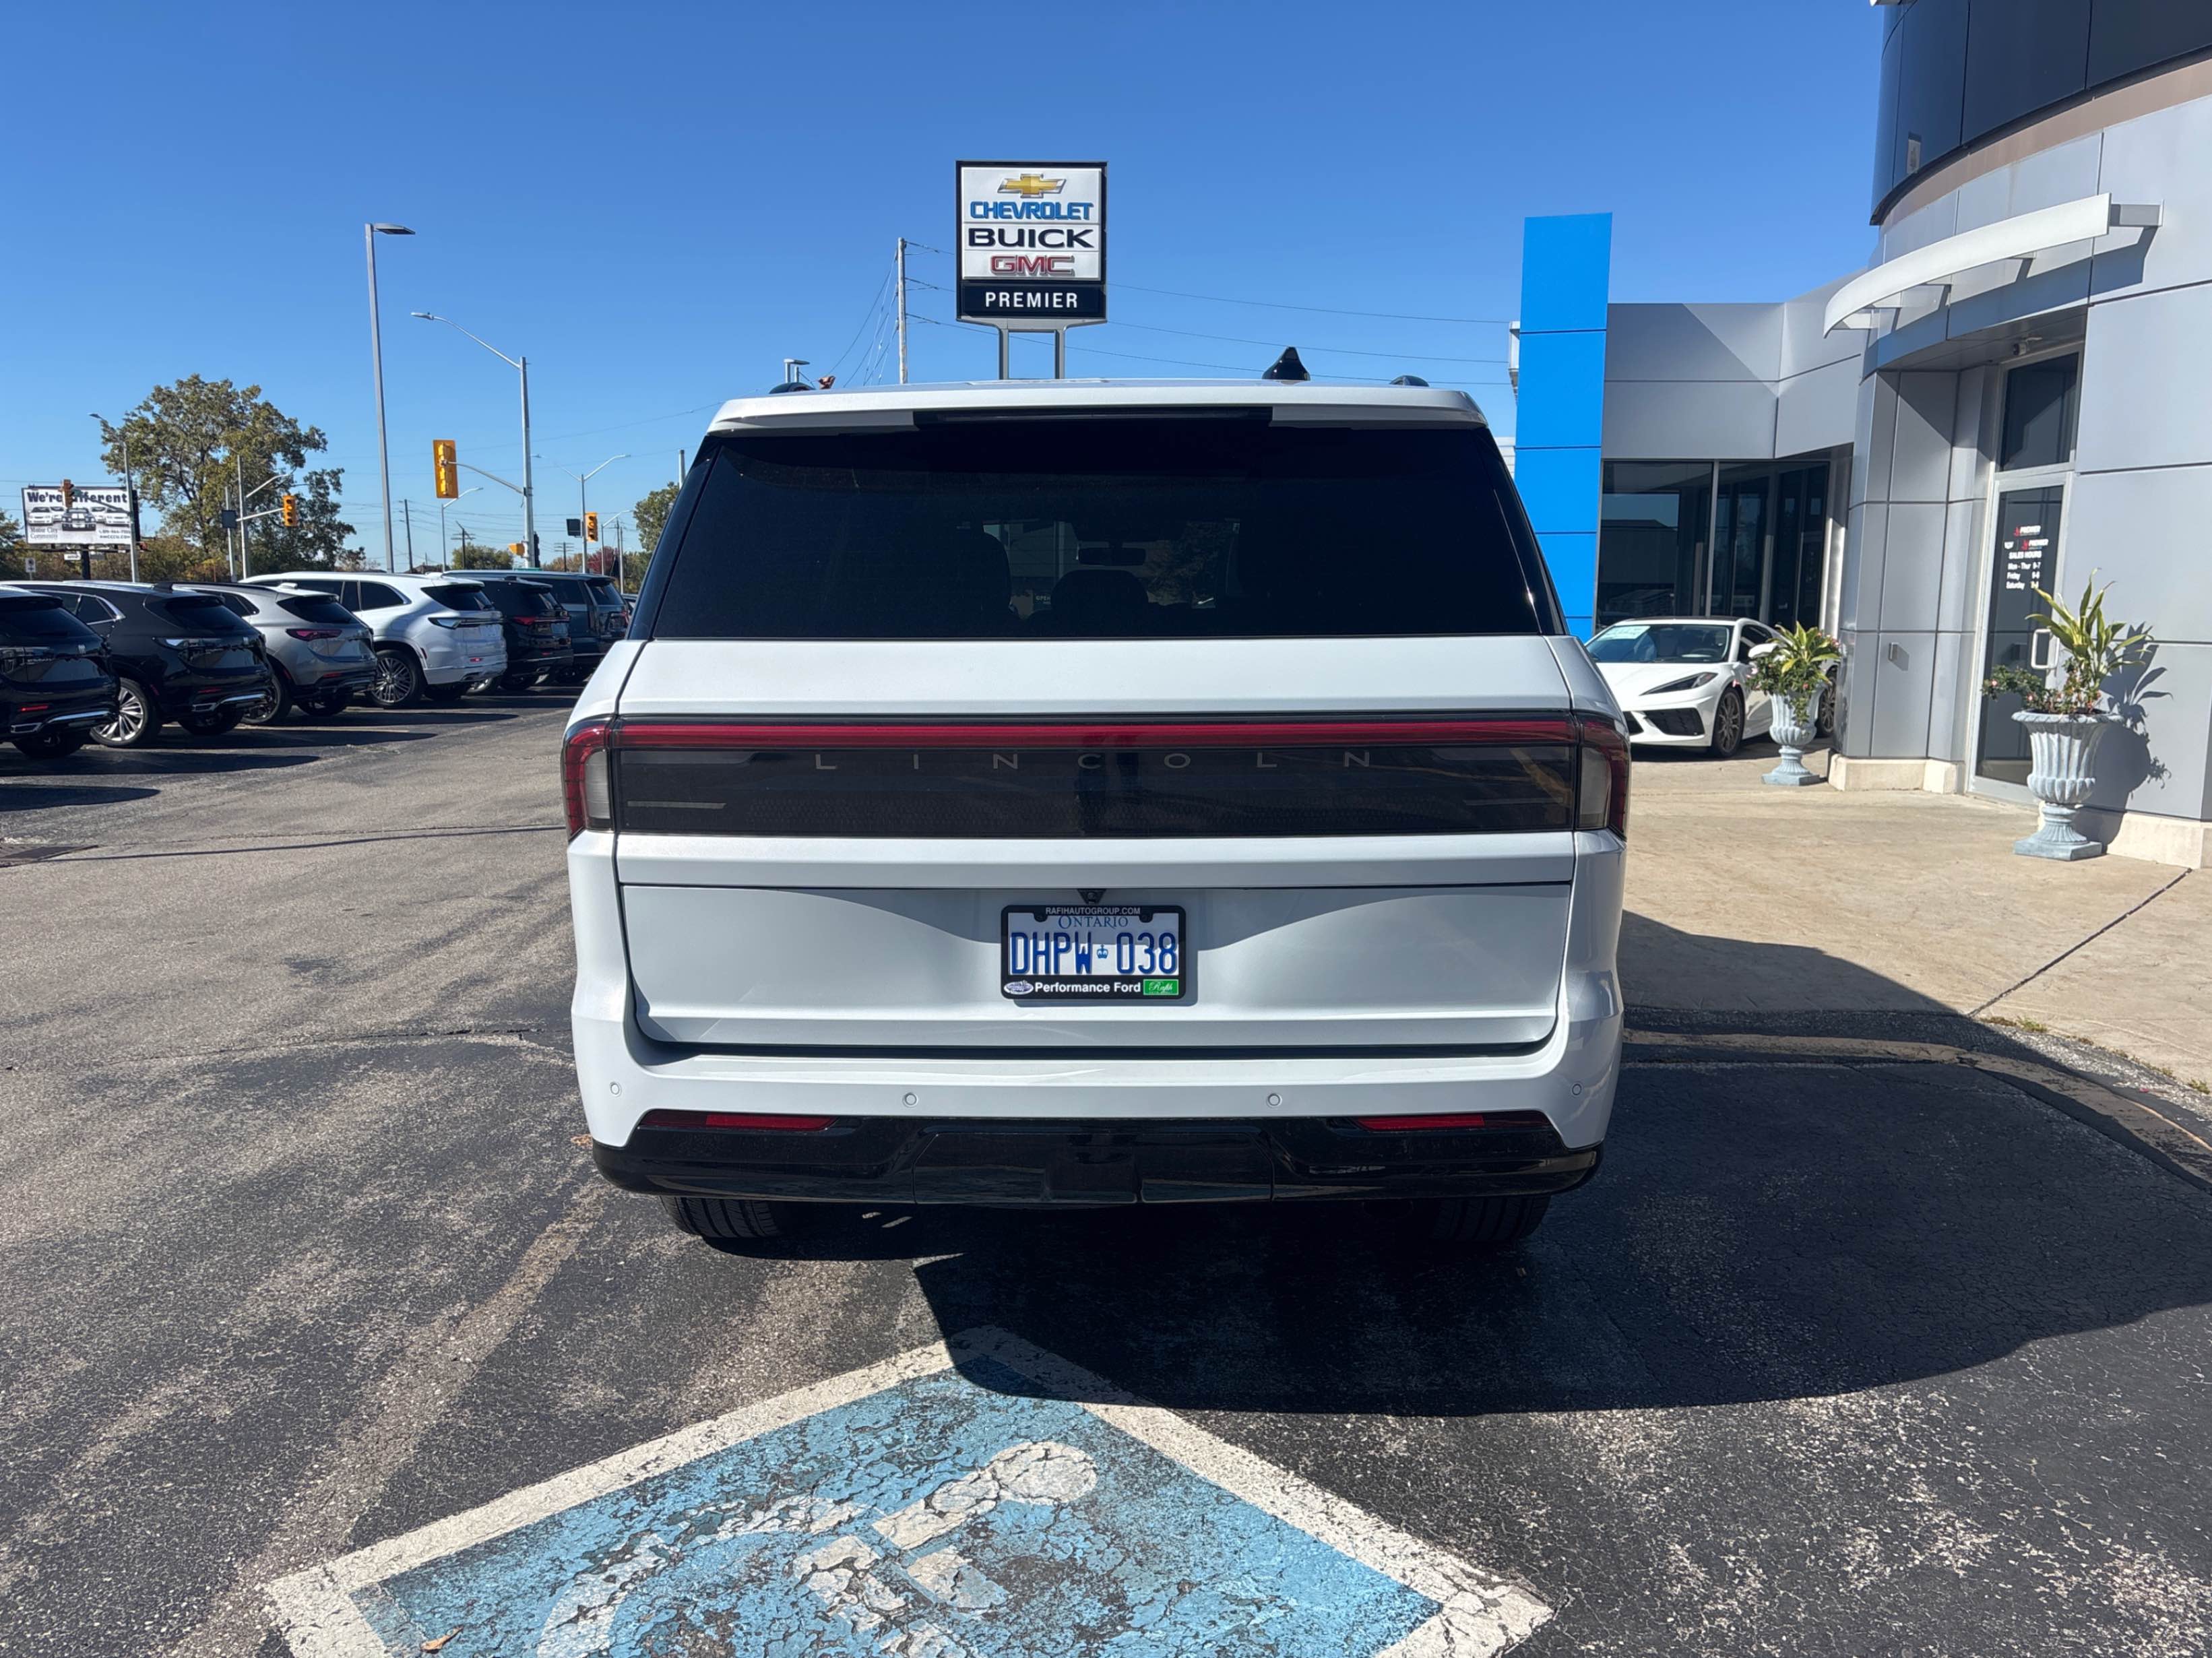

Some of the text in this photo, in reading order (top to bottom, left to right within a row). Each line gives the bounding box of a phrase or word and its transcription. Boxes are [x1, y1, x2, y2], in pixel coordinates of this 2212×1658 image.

[970, 201, 1094, 220] CHEVROLET
[968, 228, 1094, 248] BUICK
[990, 255, 1075, 276] GMC
[985, 292, 1078, 308] PREMIER
[27, 490, 127, 503] We're fferent
[815, 751, 1370, 771] LINCOLN
[1045, 907, 1141, 915] RAFIHAUTOGROUP.COM
[1058, 915, 1129, 929] ONTARIO
[1010, 931, 1177, 975] DHPW 038
[1034, 982, 1110, 992] Performance
[1114, 982, 1141, 992] Ford
